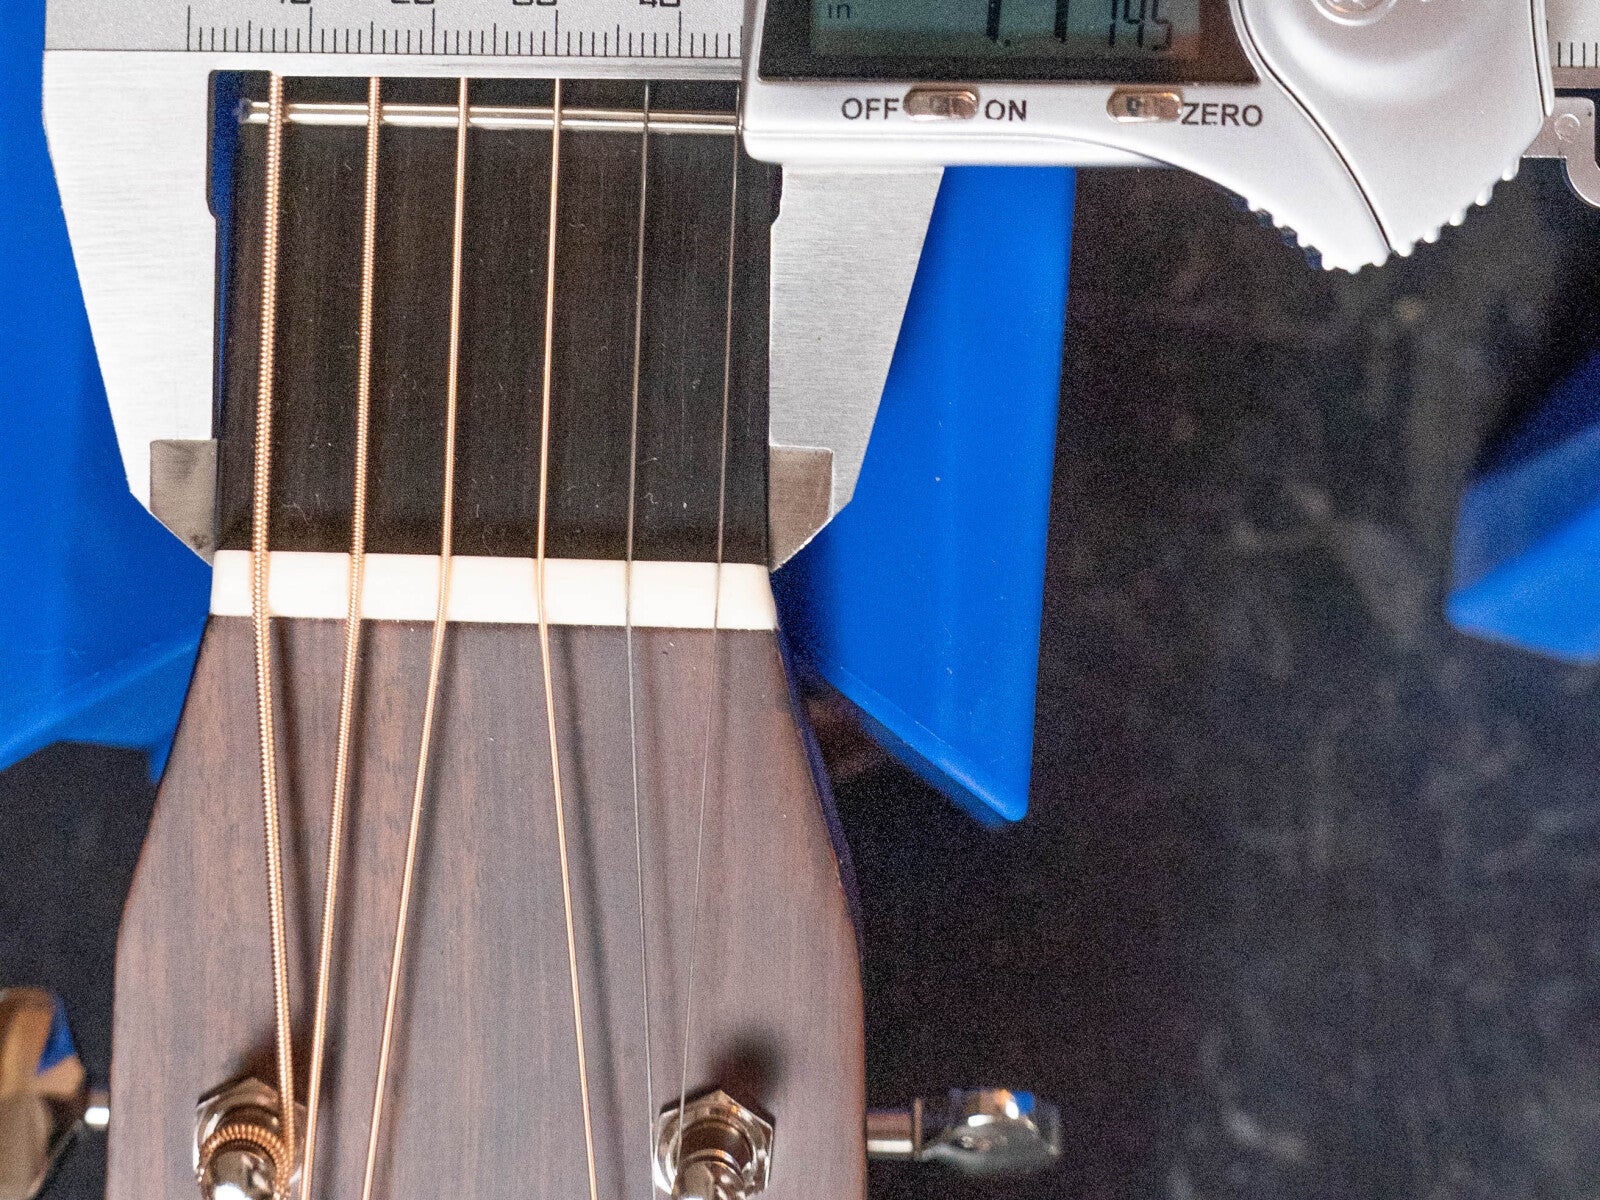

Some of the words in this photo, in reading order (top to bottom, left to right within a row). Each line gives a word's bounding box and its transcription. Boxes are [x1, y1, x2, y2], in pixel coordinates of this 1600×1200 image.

[842, 98, 899, 121] OFF
[985, 99, 1027, 121] ON
[1181, 102, 1263, 127] ZERO
